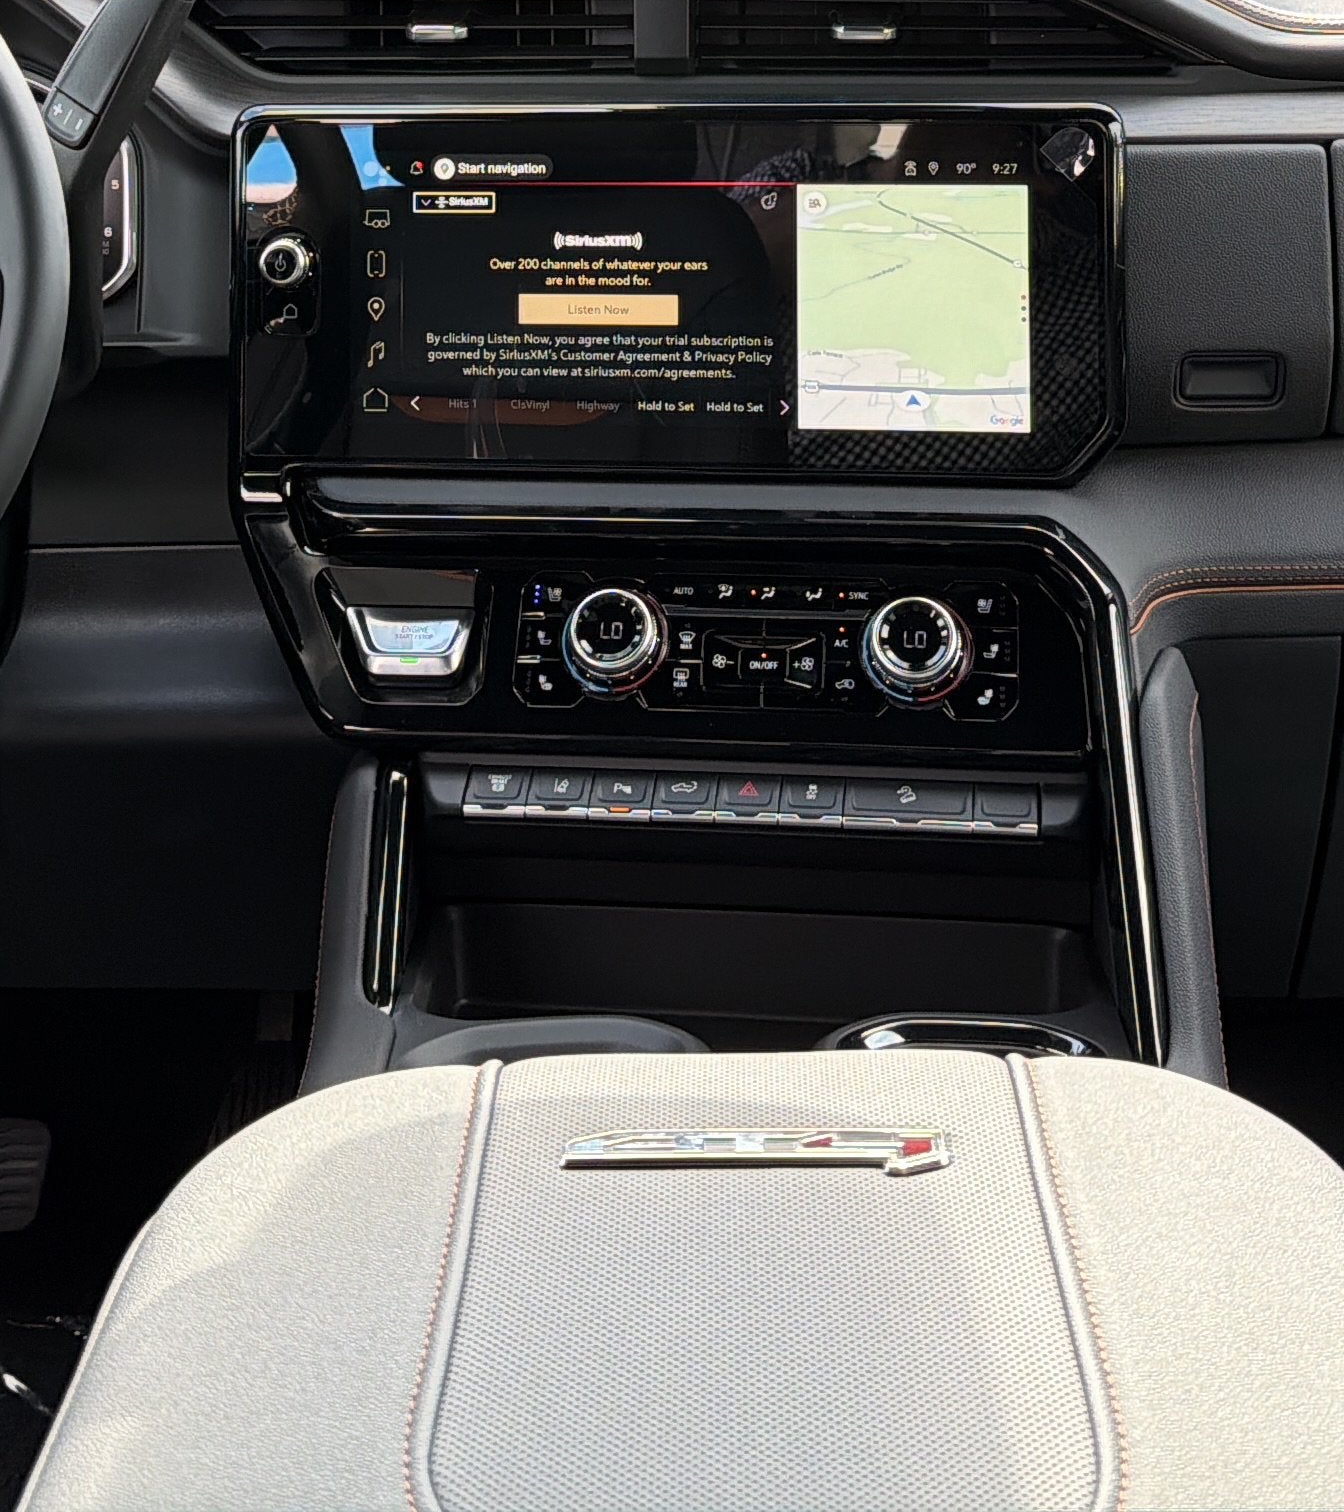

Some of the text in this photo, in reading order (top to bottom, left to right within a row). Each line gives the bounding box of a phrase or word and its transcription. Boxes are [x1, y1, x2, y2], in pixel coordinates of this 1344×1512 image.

[457, 162, 546, 177] Start navigation
[992, 163, 1018, 175] 9:27
[111, 179, 120, 189] 5
[448, 197, 489, 207] SiriusXM
[104, 227, 113, 237] 6
[490, 258, 708, 273] Over 200 channels of whatever your ears
[545, 275, 651, 287] are in the mood for.
[568, 304, 630, 315] Listen Now
[426, 333, 774, 350] By clicking Listen Now, you agree that your trial subscription is
[428, 349, 773, 366] governed by SiriusXM's Customer Agreement & Privacy Policy
[462, 365, 496, 377] which
[497, 368, 518, 379] you
[520, 368, 540, 377] can
[543, 366, 568, 377] view
[570, 367, 582, 377] at
[448, 397, 468, 409] Hits
[576, 399, 620, 413] Highway
[638, 400, 694, 412] Hold to Set
[706, 401, 764, 413] Hold to Set
[990, 414, 1024, 427] Google
[673, 587, 694, 596] AUTO
[848, 591, 870, 601] SYNC
[401, 626, 430, 635] ENGINE
[599, 622, 623, 640] LO
[834, 639, 849, 648] A/C
[903, 630, 927, 649] LO
[749, 661, 779, 670] ON/OFF
